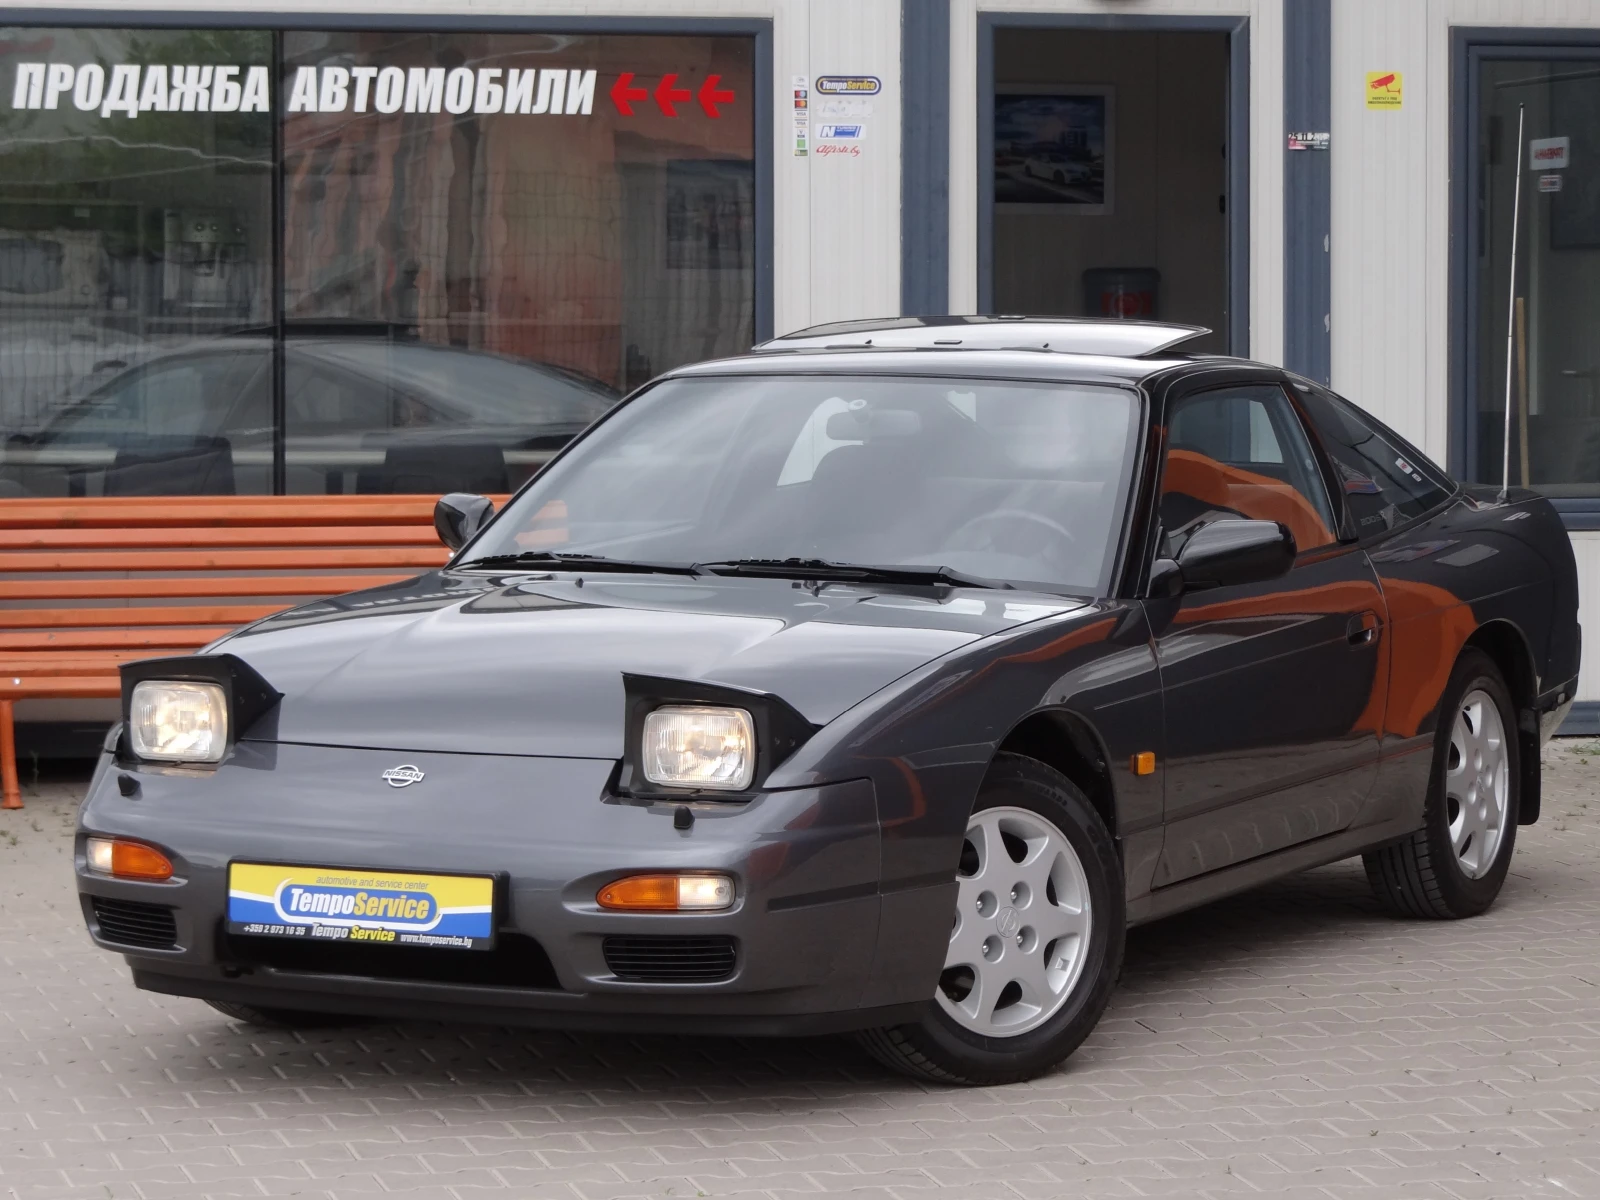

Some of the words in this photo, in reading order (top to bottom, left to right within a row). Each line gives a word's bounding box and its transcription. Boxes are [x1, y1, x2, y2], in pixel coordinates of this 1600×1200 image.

[12, 62, 270, 118] ПРОДАЖБА
[288, 66, 597, 116] АВТОМОБИЛИ
[822, 81, 875, 92] TempoService
[384, 771, 422, 779] NISSAN
[316, 876, 358, 886] automotive
[359, 878, 374, 887] and
[375, 879, 403, 889] service
[404, 880, 429, 890] center
[290, 888, 429, 919] TempoService
[263, 925, 269, 933] 2
[285, 926, 295, 935] 16
[295, 927, 306, 936] 35
[311, 922, 348, 939] Tempo
[350, 925, 396, 941] Service
[400, 933, 473, 948] www.temposervice.bg
